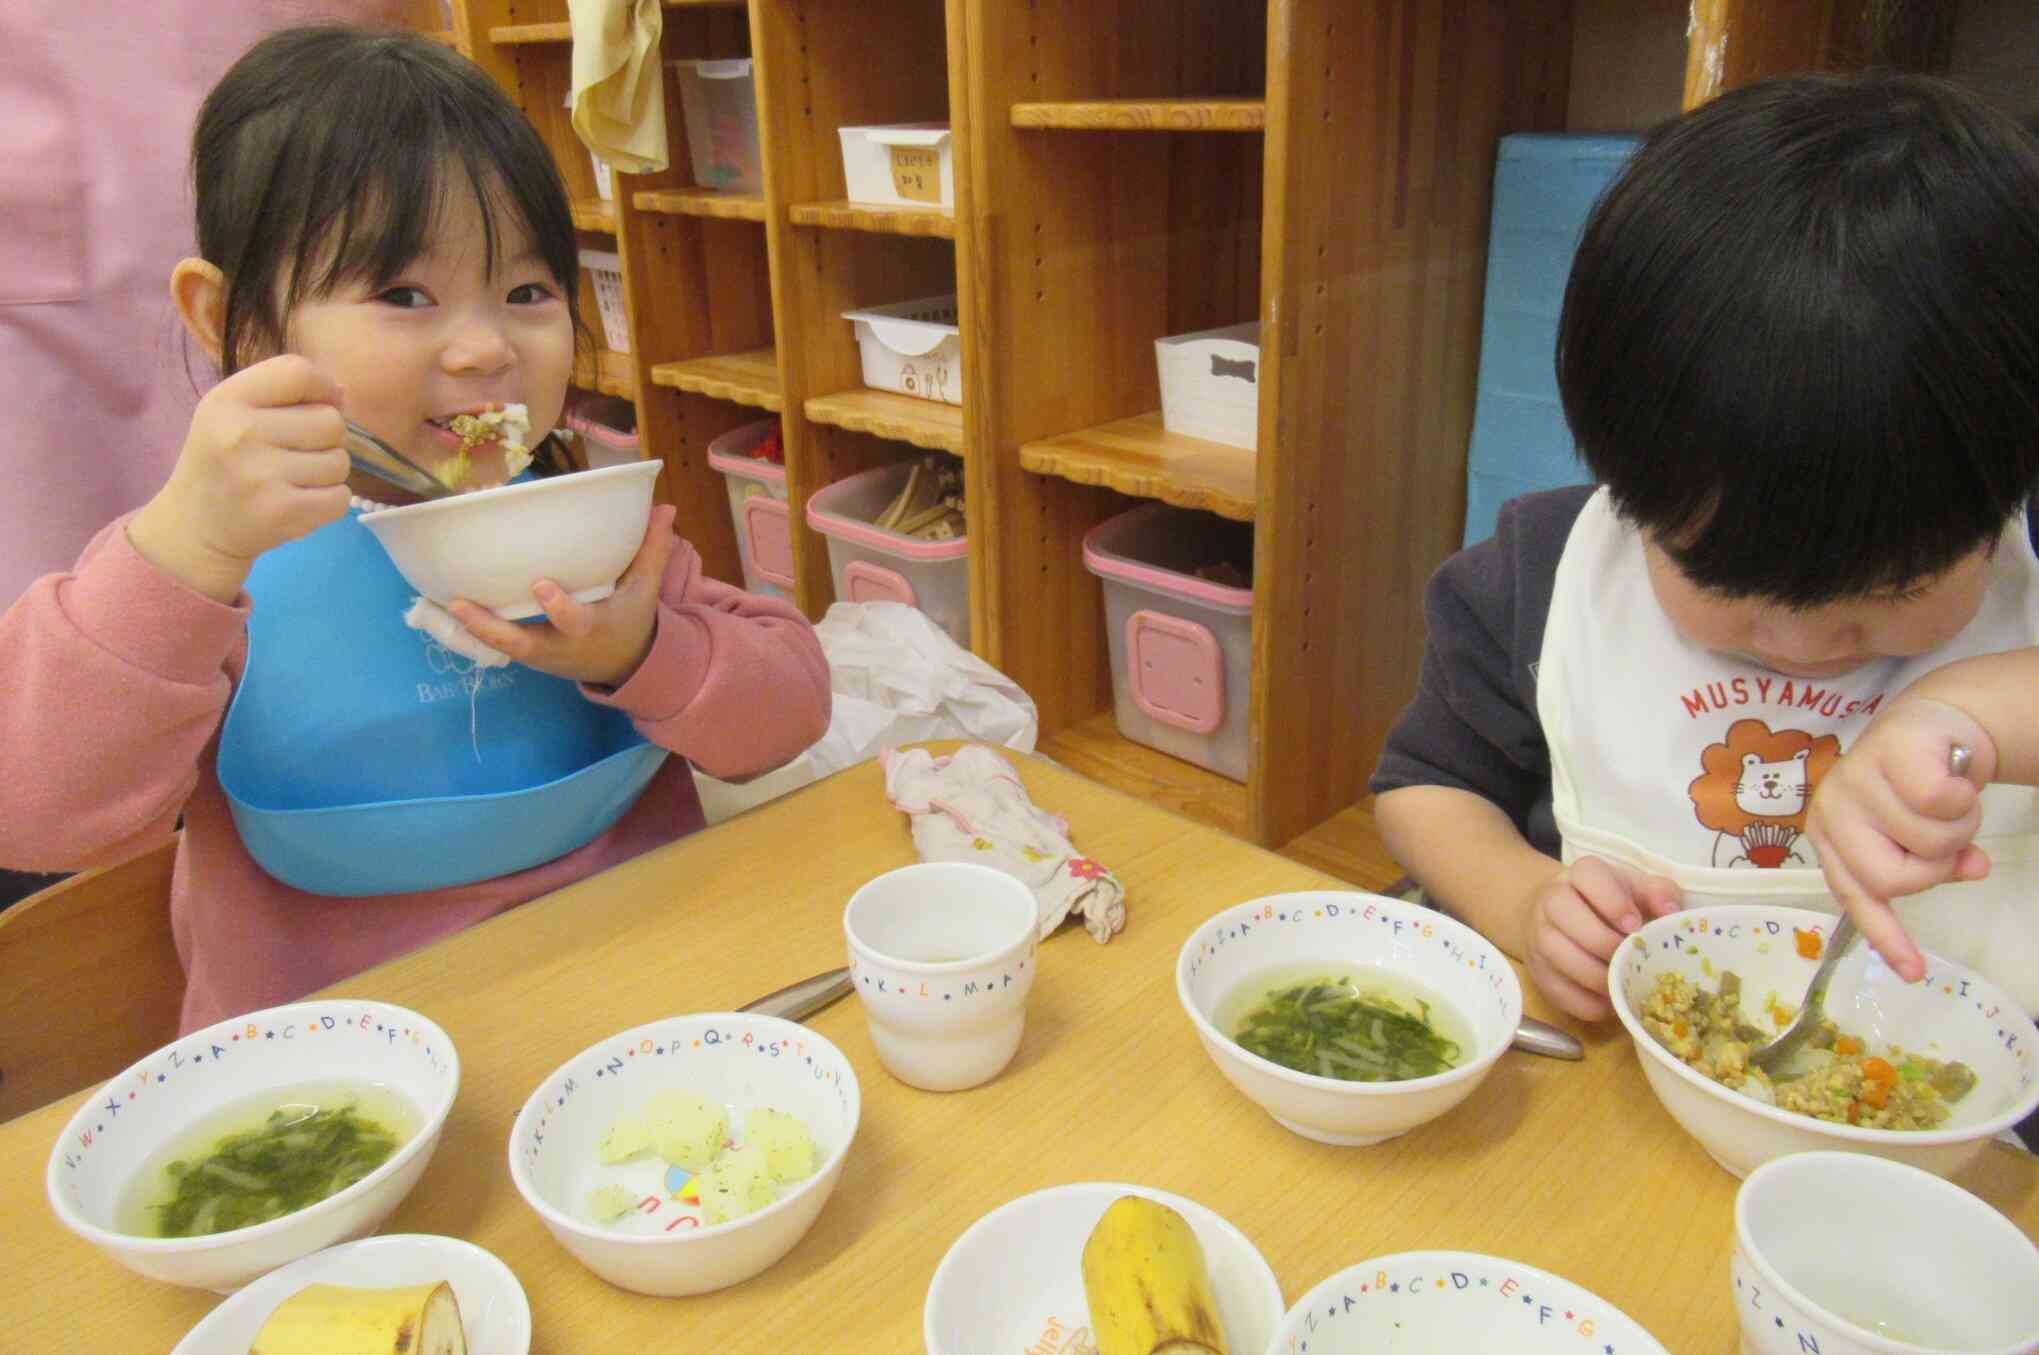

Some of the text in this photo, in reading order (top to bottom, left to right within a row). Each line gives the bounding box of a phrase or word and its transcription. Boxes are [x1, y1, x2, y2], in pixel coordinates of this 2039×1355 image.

[1263, 904, 1273, 920] B
[1291, 909, 1303, 922] C
[1326, 903, 1340, 917] D
[1363, 904, 1377, 921] E
[1393, 920, 1403, 936] F
[1765, 920, 1781, 935] D
[877, 979, 888, 993] K
[964, 981, 978, 996] M
[104, 1097, 121, 1118] X
[211, 1044, 226, 1060] A
[246, 1023, 257, 1039] B
[282, 1024, 297, 1040] C
[320, 1015, 336, 1030] D
[360, 1013, 373, 1031] E
[388, 1028, 397, 1045] F
[606, 1056, 625, 1076] N
[640, 1039, 655, 1055] O
[671, 1039, 681, 1055] P
[703, 1029, 724, 1045] Q
[768, 1041, 780, 1057] S
[1343, 1295, 1357, 1314] A
[1376, 1271, 1387, 1290] B
[1408, 1276, 1423, 1294] C
[1450, 1272, 1469, 1289] D
[1499, 1277, 1519, 1297] E
[1540, 1304, 1552, 1325] F
[1576, 1319, 1594, 1337] G
[1797, 1331, 1820, 1355] N
